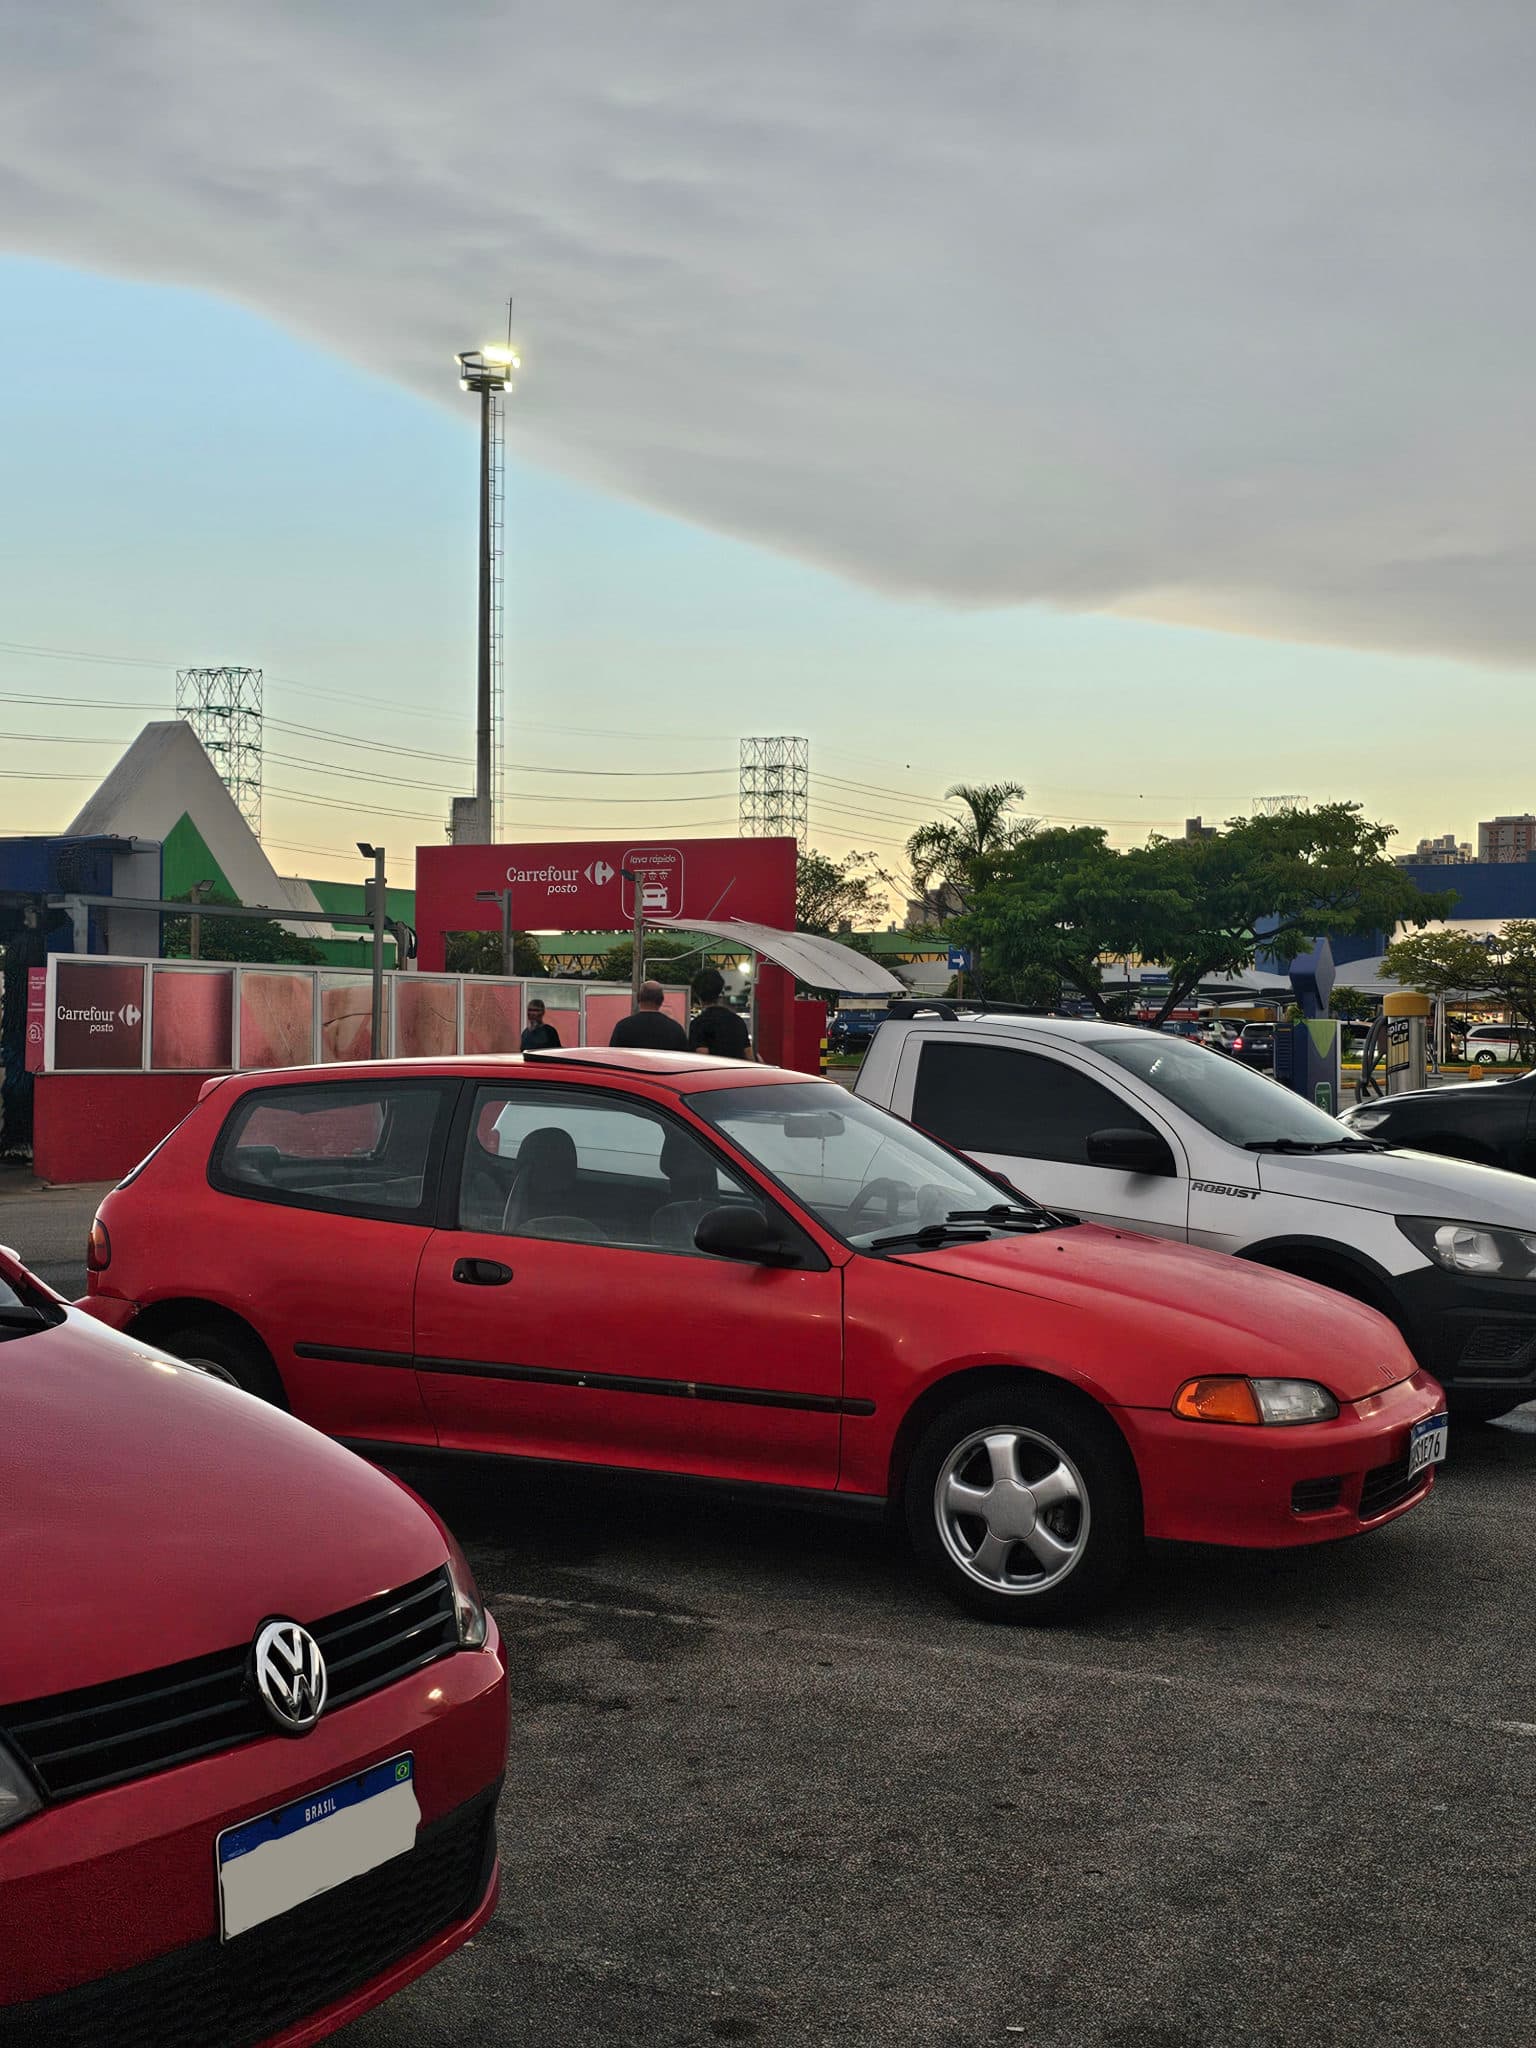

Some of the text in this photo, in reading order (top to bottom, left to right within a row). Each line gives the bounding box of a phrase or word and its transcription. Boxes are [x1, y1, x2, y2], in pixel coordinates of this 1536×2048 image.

[630, 855, 648, 864] lava
[506, 866, 579, 882] Carrefour
[547, 884, 578, 896] posto
[57, 1006, 115, 1021] Carrefour
[89, 1023, 114, 1034] posto
[1392, 1032, 1409, 1044] Car
[1191, 1182, 1261, 1200] ROBUST
[305, 1797, 337, 1822] BRASIL
